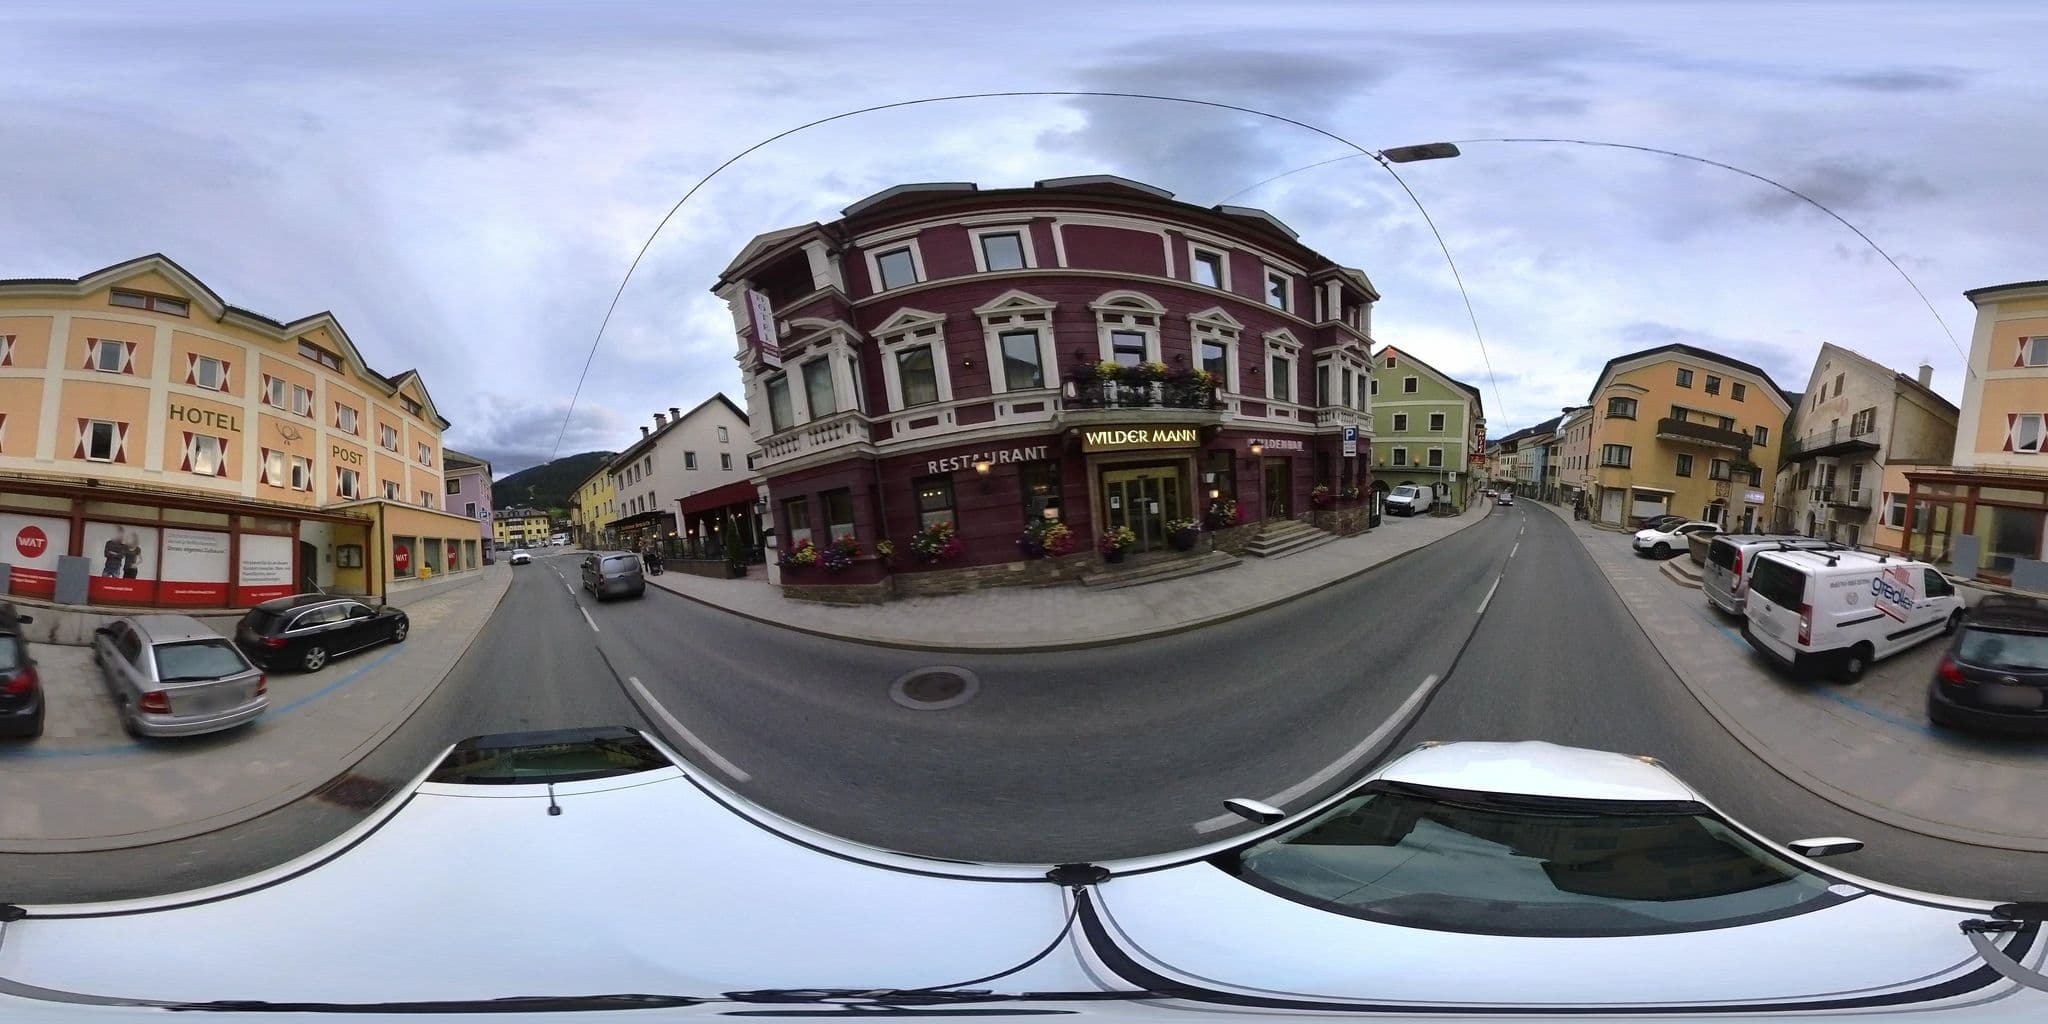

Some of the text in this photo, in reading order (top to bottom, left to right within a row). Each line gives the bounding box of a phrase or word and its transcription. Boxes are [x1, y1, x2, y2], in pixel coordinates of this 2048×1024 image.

[169, 404, 241, 432] HOTEL
[1086, 429, 1196, 445] WILDER MANN
[1345, 429, 1354, 441] P
[332, 445, 364, 466] POST
[927, 445, 1048, 474] RESTAURANT
[18, 536, 46, 548] WAT
[395, 553, 408, 562] WAT
[1871, 577, 1914, 610] gredler
